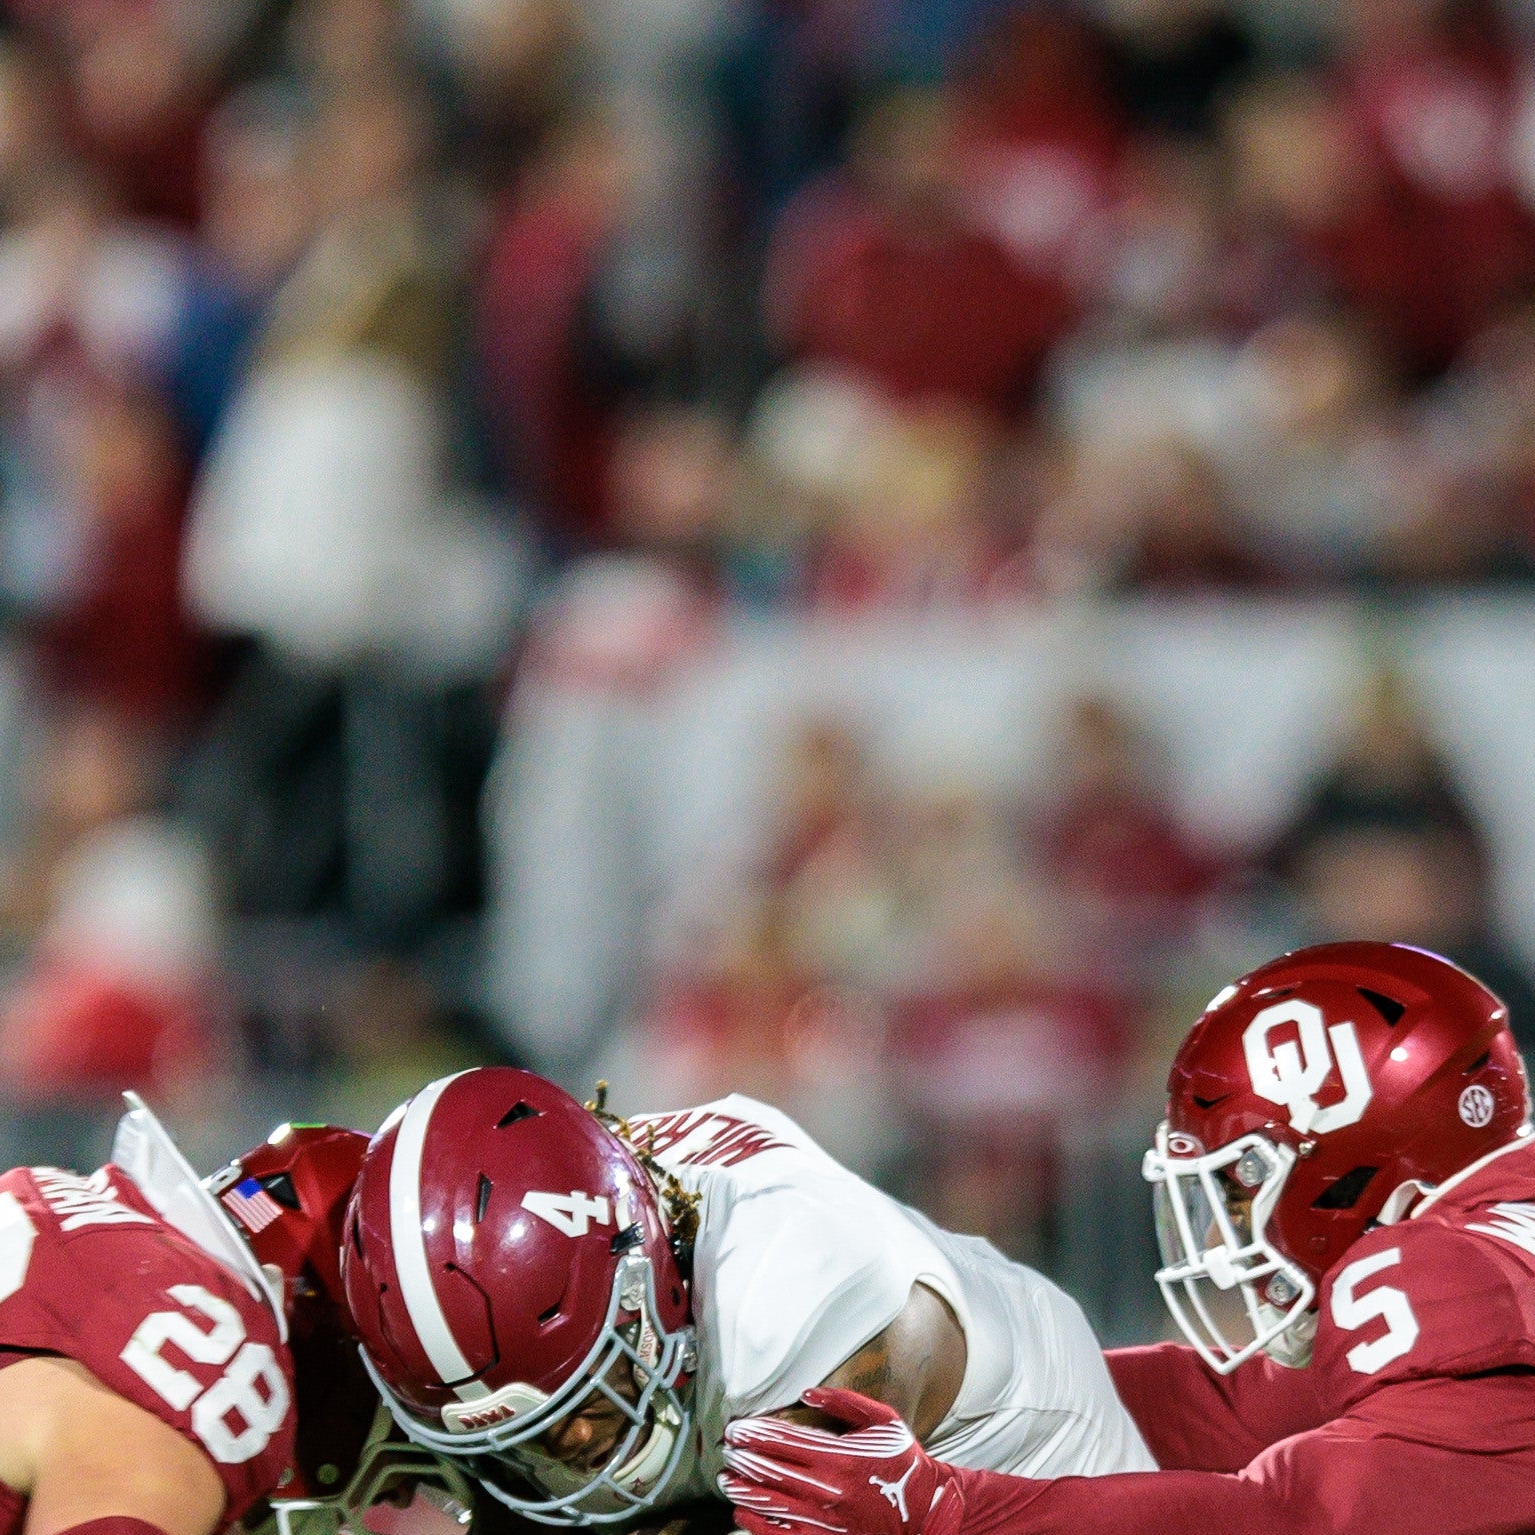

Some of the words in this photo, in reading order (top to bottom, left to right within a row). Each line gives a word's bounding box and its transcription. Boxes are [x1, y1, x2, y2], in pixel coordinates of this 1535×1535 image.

[1242, 999, 1374, 1135] OU
[520, 1190, 610, 1238] 4
[119, 1284, 291, 1464] 28
[1331, 1247, 1420, 1375] 5
